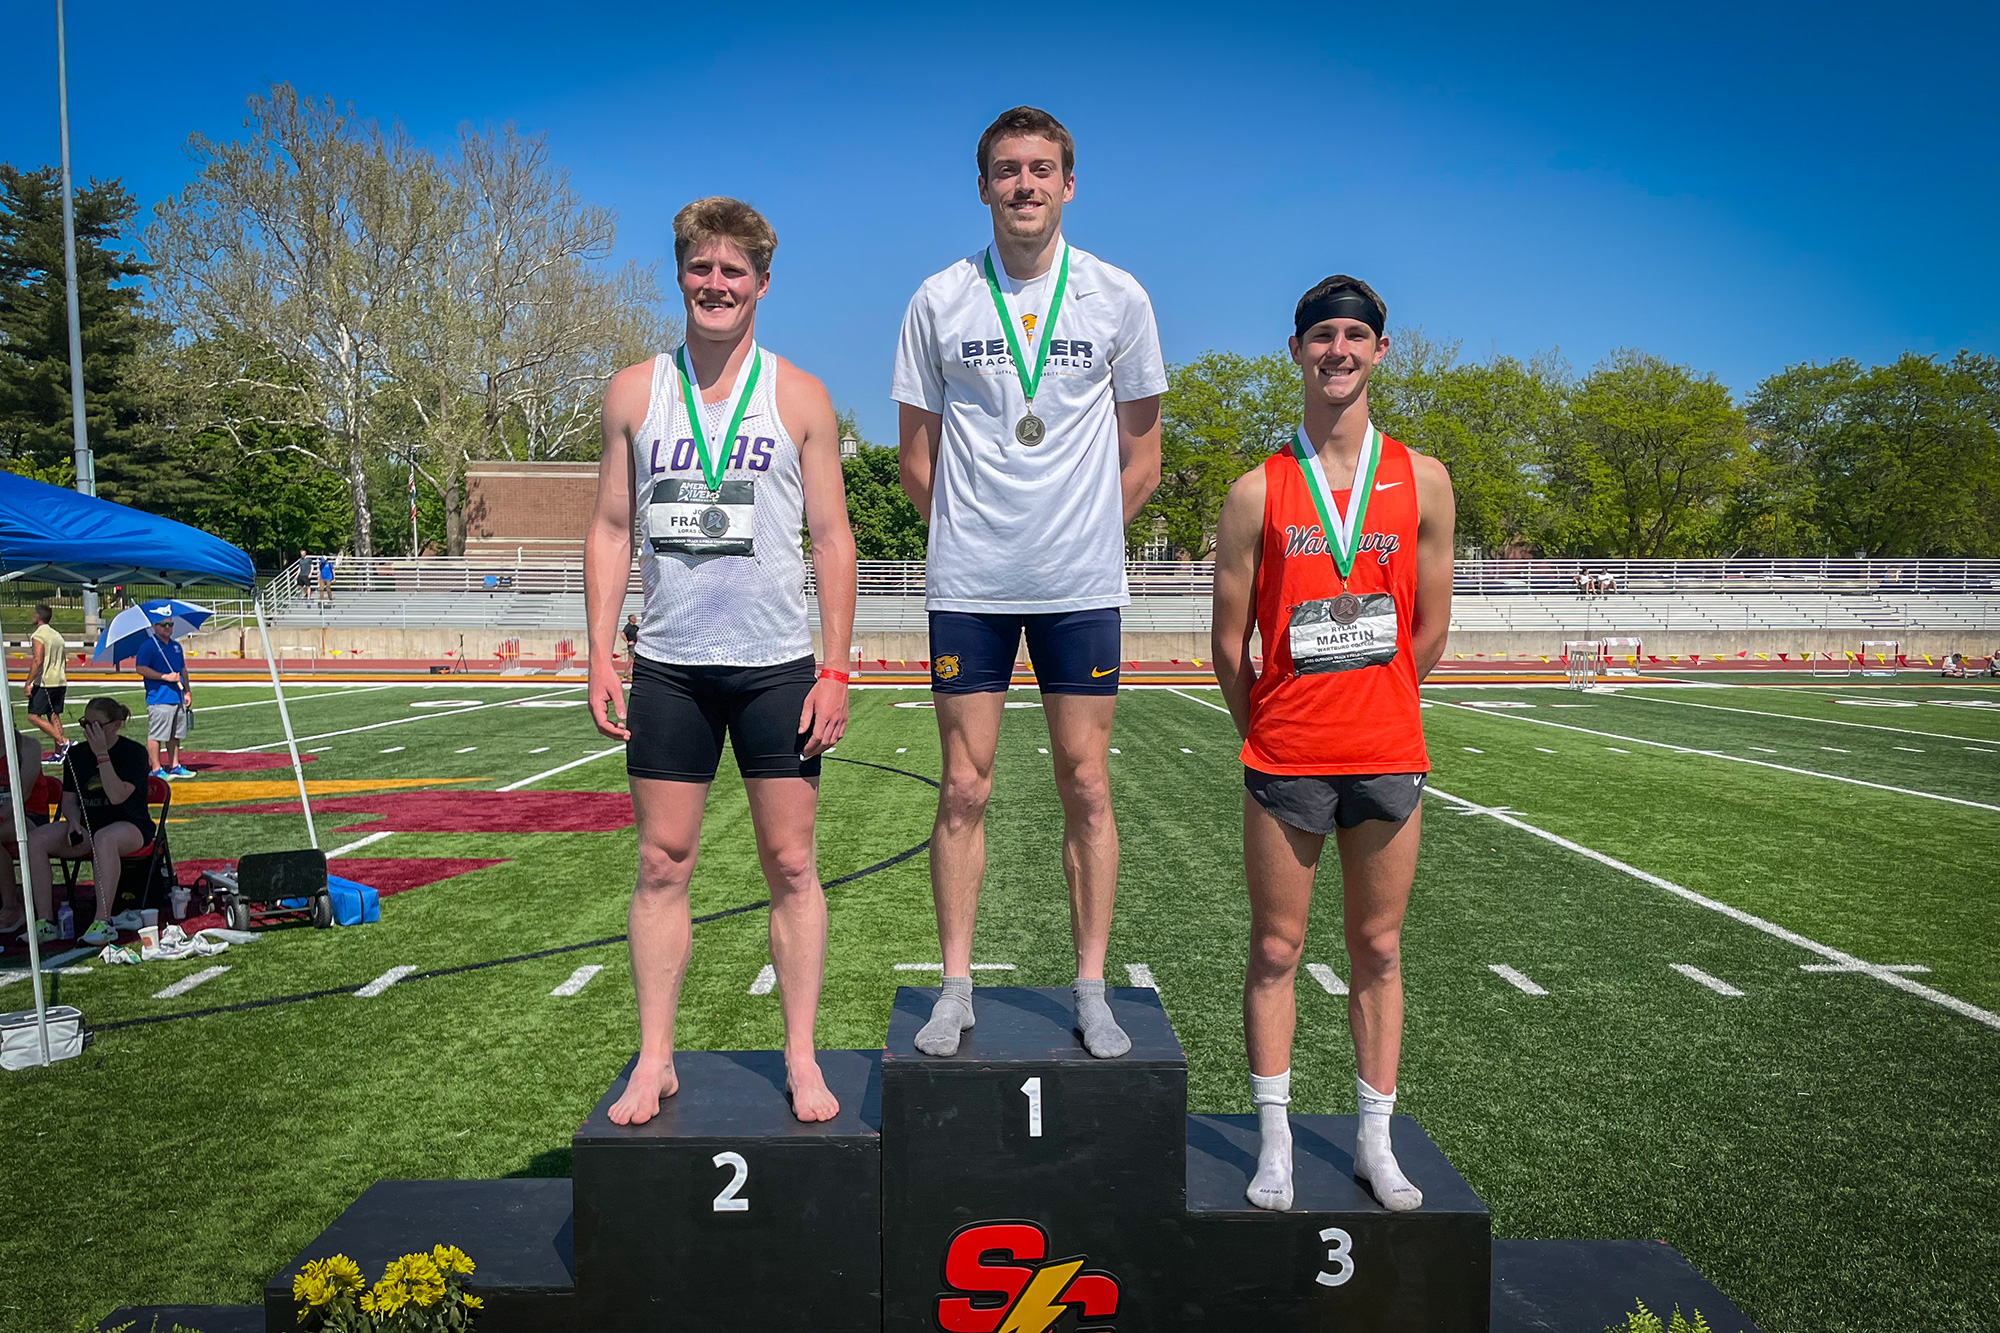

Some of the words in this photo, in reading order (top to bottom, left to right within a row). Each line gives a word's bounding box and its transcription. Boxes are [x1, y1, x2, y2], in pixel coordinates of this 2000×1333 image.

[961, 338, 1093, 358] BEER
[963, 356, 1015, 368] TRACK
[1044, 358, 1092, 369] FIELD
[1285, 525, 1400, 565] Warurg
[1316, 630, 1375, 646] MARTIN
[1331, 624, 1357, 633] RYLAN
[1020, 1077, 1042, 1137] 1
[712, 1151, 749, 1211] 2
[1315, 1227, 1355, 1287] 3
